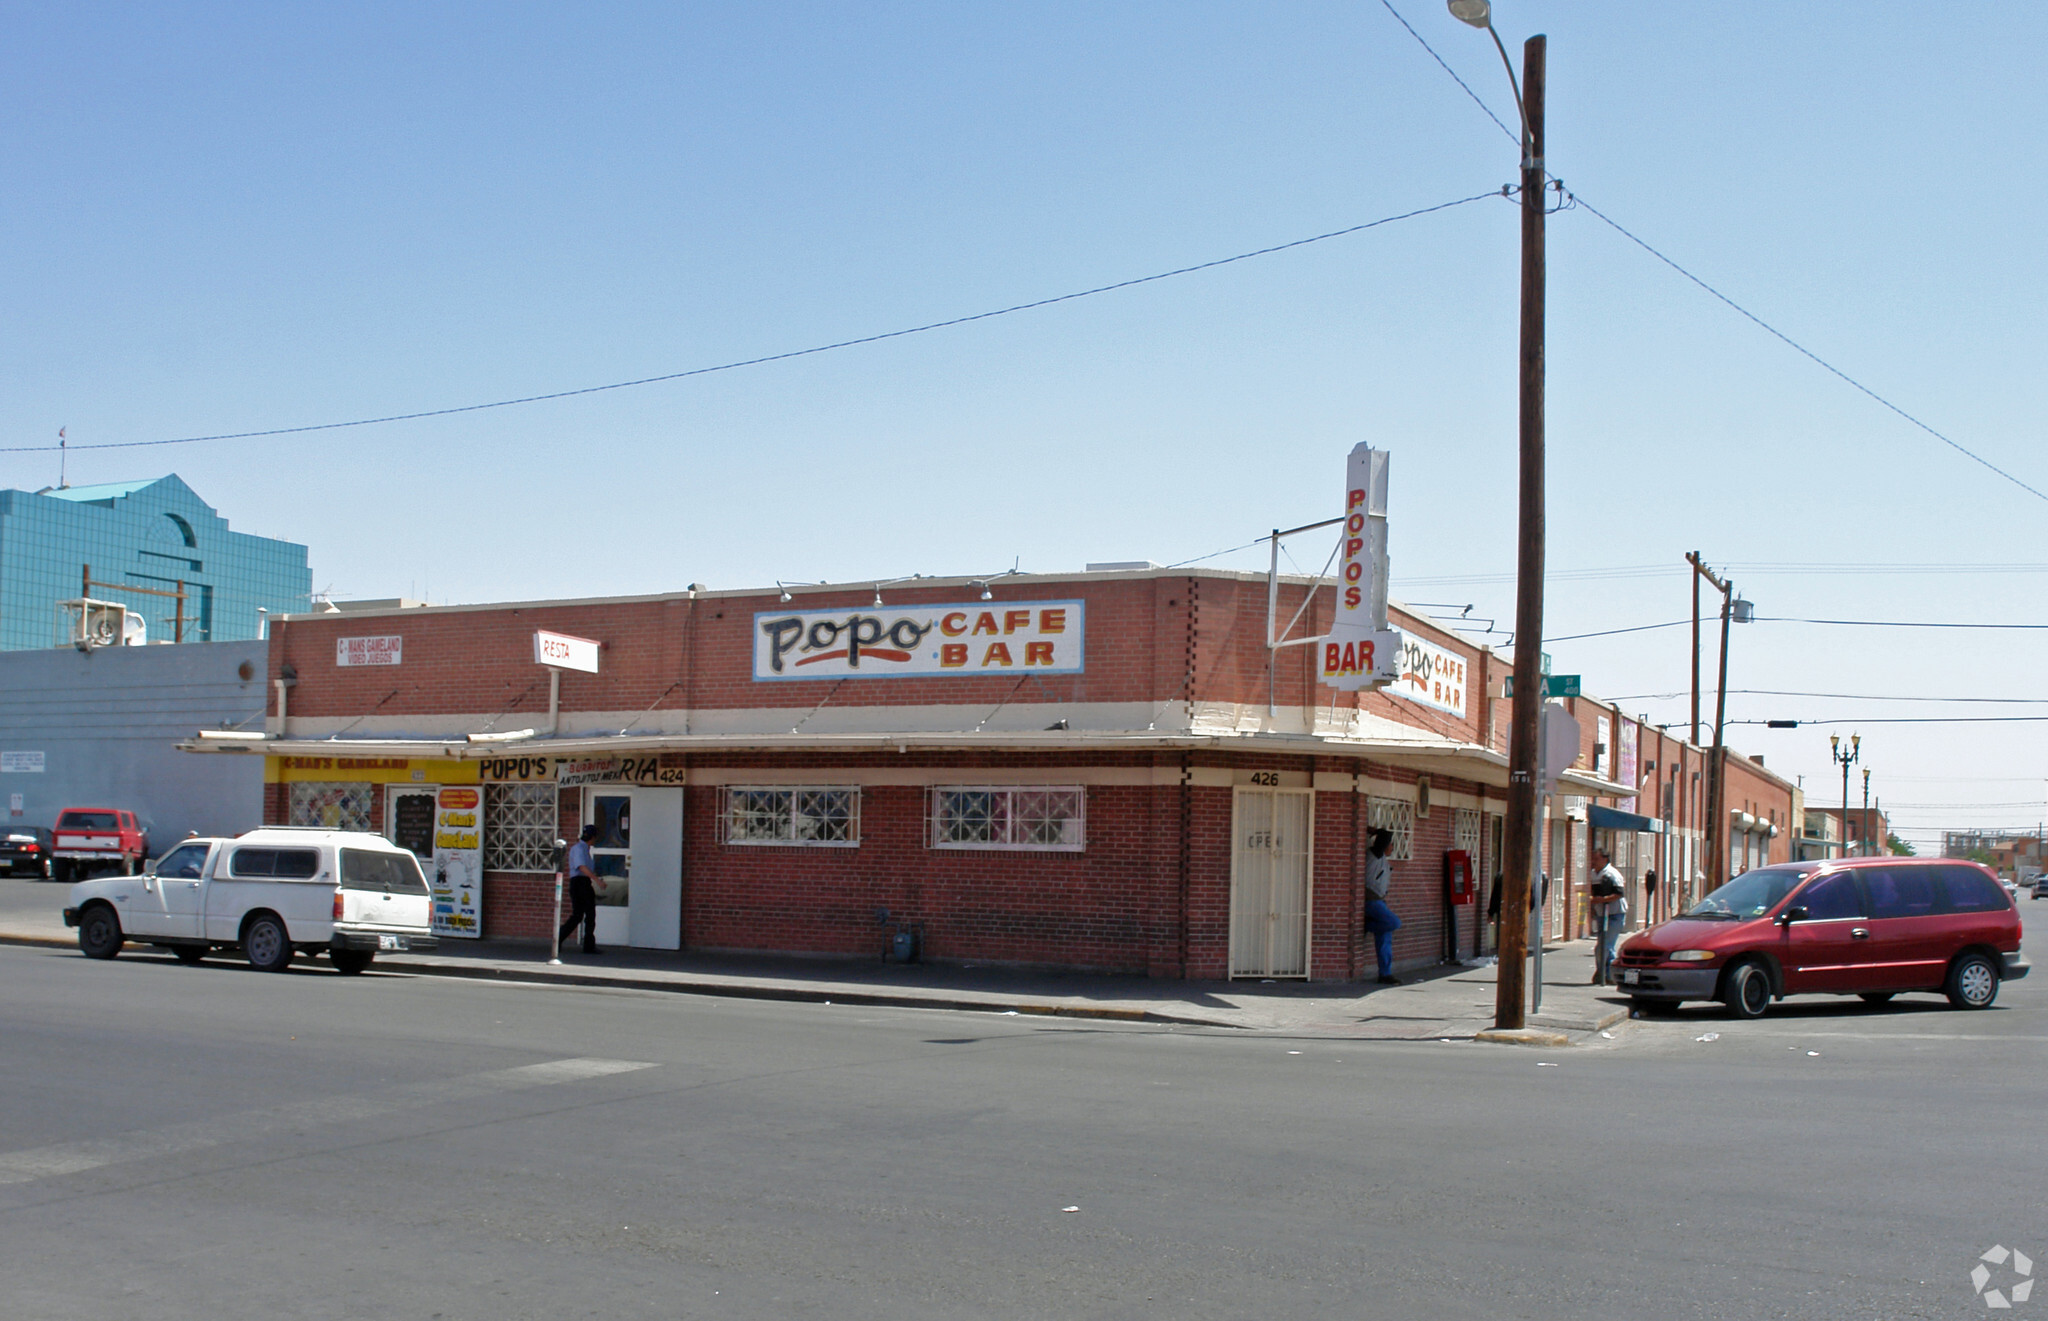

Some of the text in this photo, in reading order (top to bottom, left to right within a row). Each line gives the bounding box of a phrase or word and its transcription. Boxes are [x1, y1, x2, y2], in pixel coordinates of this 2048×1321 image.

[1345, 488, 1366, 611] POPOS
[940, 608, 1066, 637] CAFE
[367, 637, 400, 652] GAMELAND
[543, 639, 570, 660] RESTA
[760, 613, 933, 675] Popo
[940, 641, 1055, 668] BAR
[348, 651, 393, 665] VIDEO JUEGOS
[1323, 640, 1375, 677] BAR
[1434, 653, 1464, 684] CAFE
[1434, 681, 1461, 710] BAR
[480, 757, 547, 780] POPO'S
[660, 769, 685, 784] 424
[1250, 772, 1279, 787] 426
